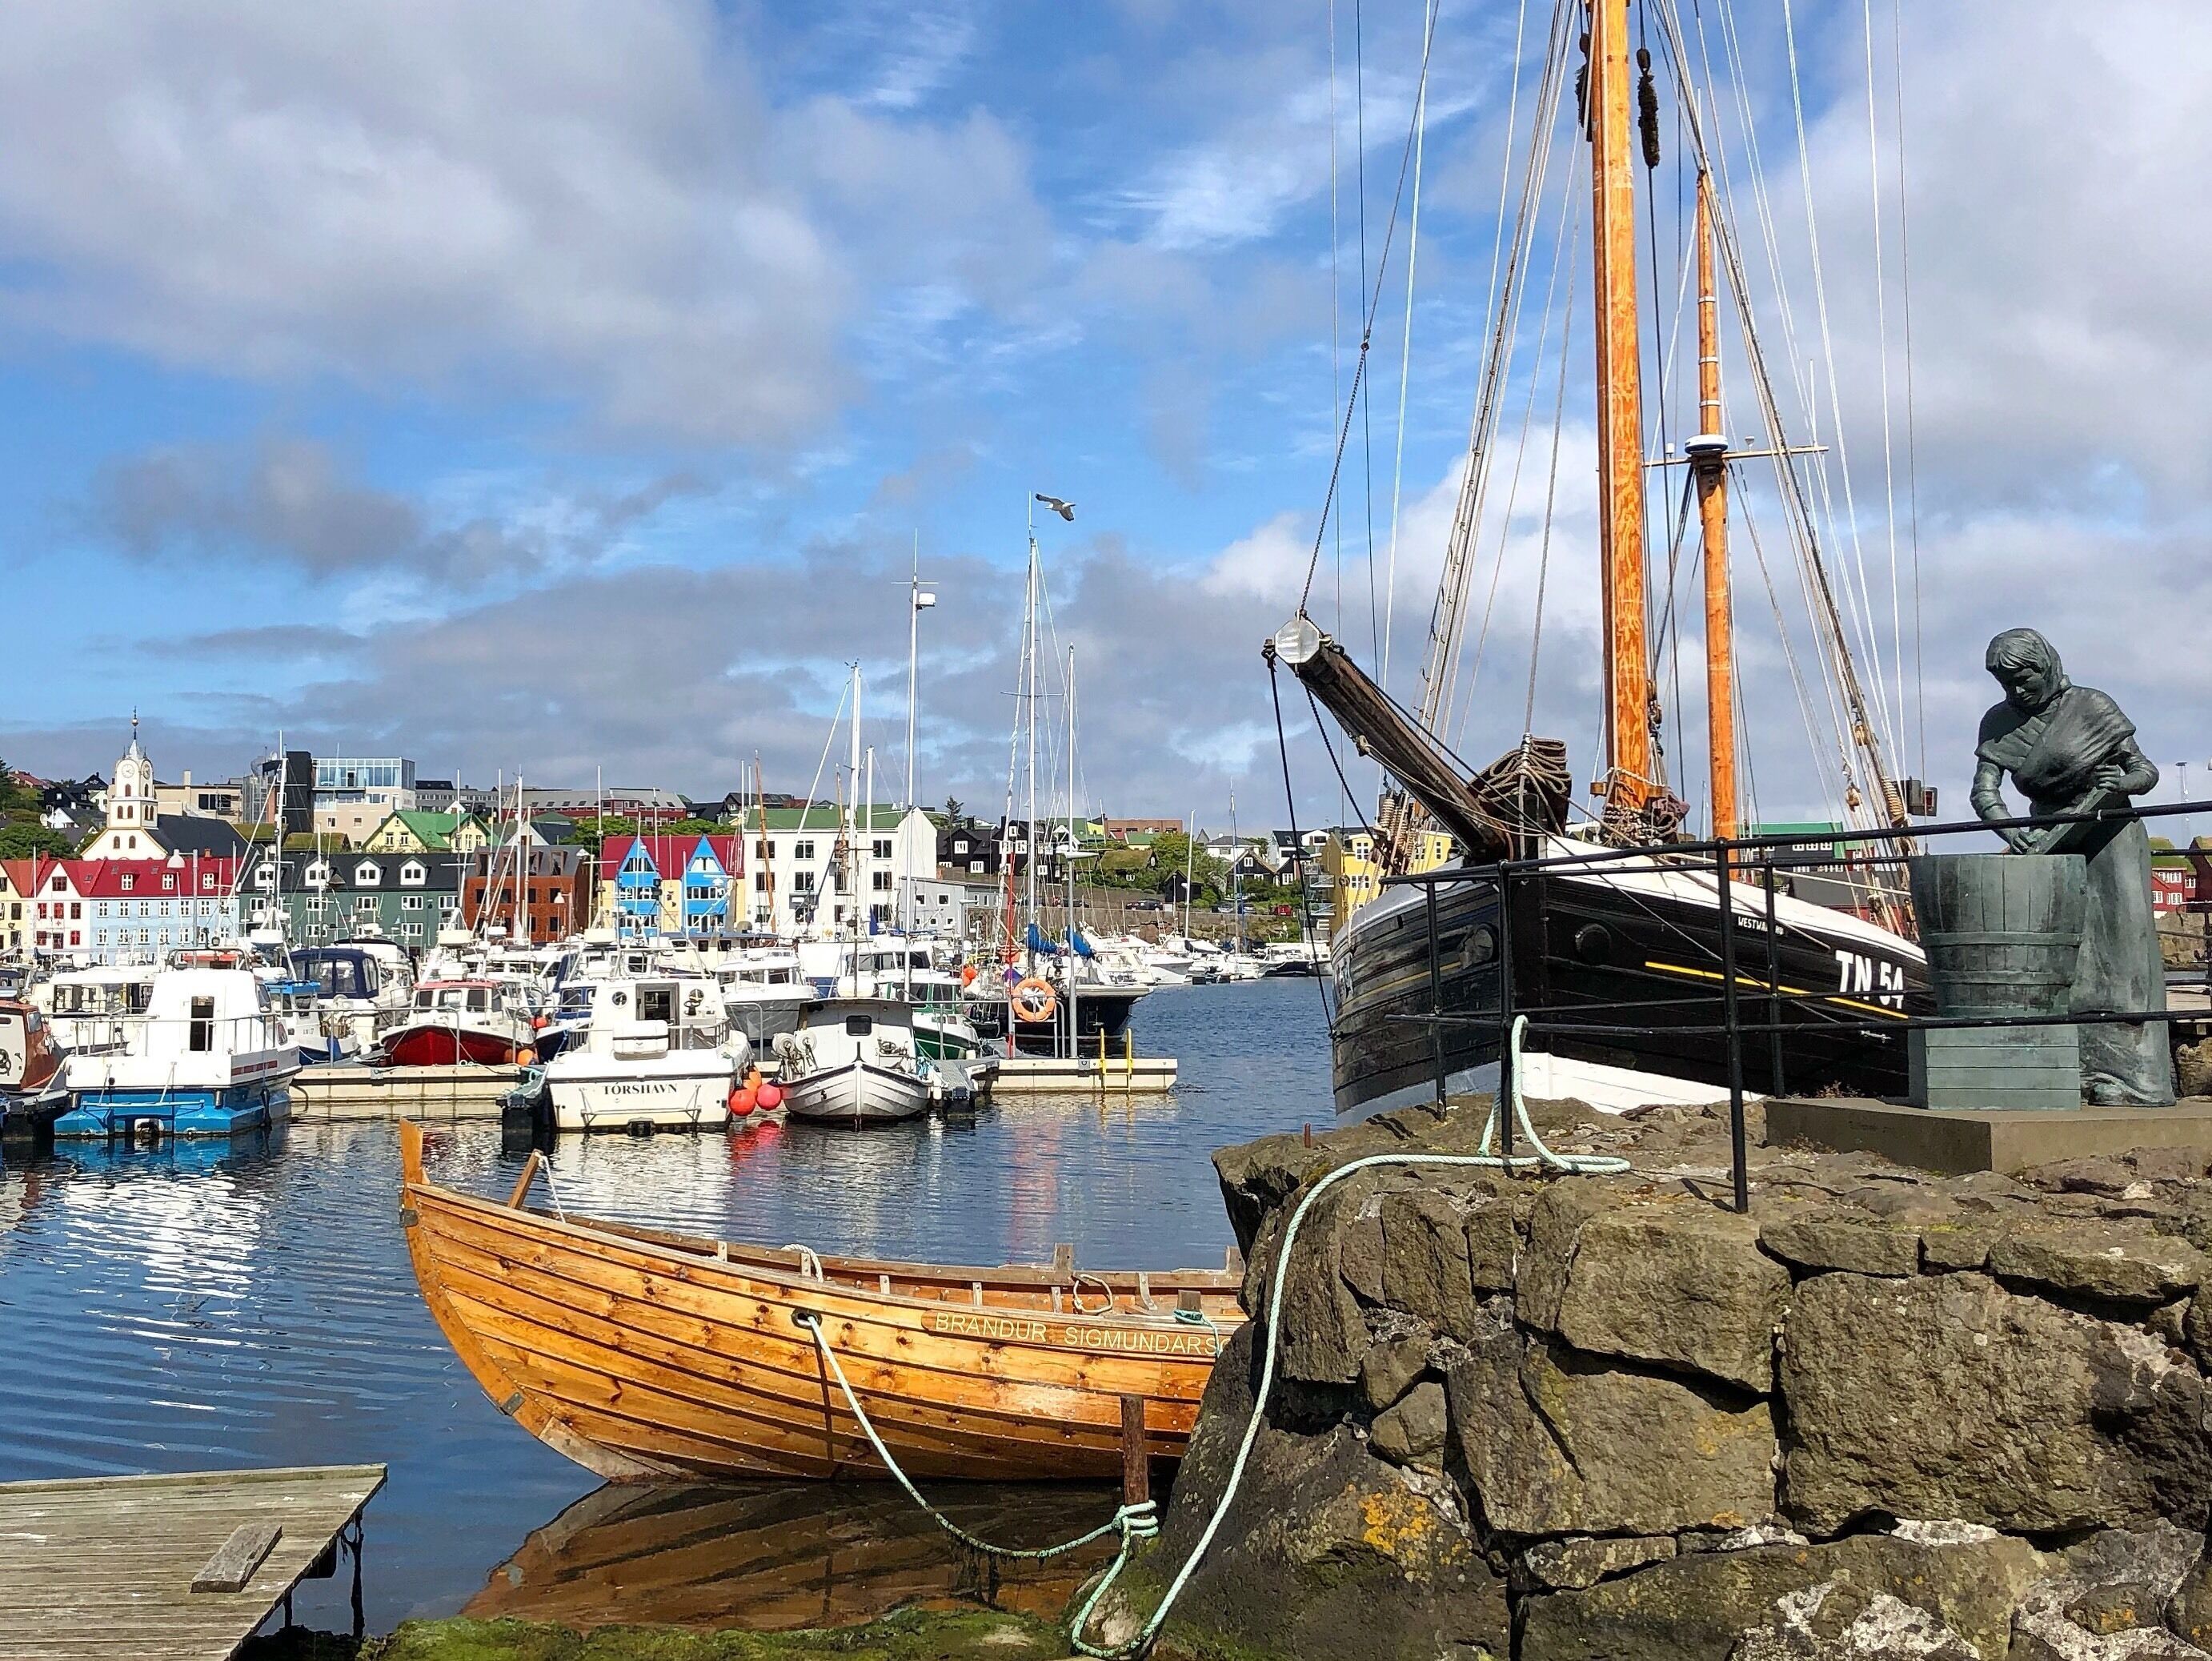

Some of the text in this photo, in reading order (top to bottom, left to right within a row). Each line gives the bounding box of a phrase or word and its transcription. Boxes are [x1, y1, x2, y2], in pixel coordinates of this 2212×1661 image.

[1835, 949, 1904, 1009] TN 54
[935, 1312, 1047, 1342] BRANDUR
